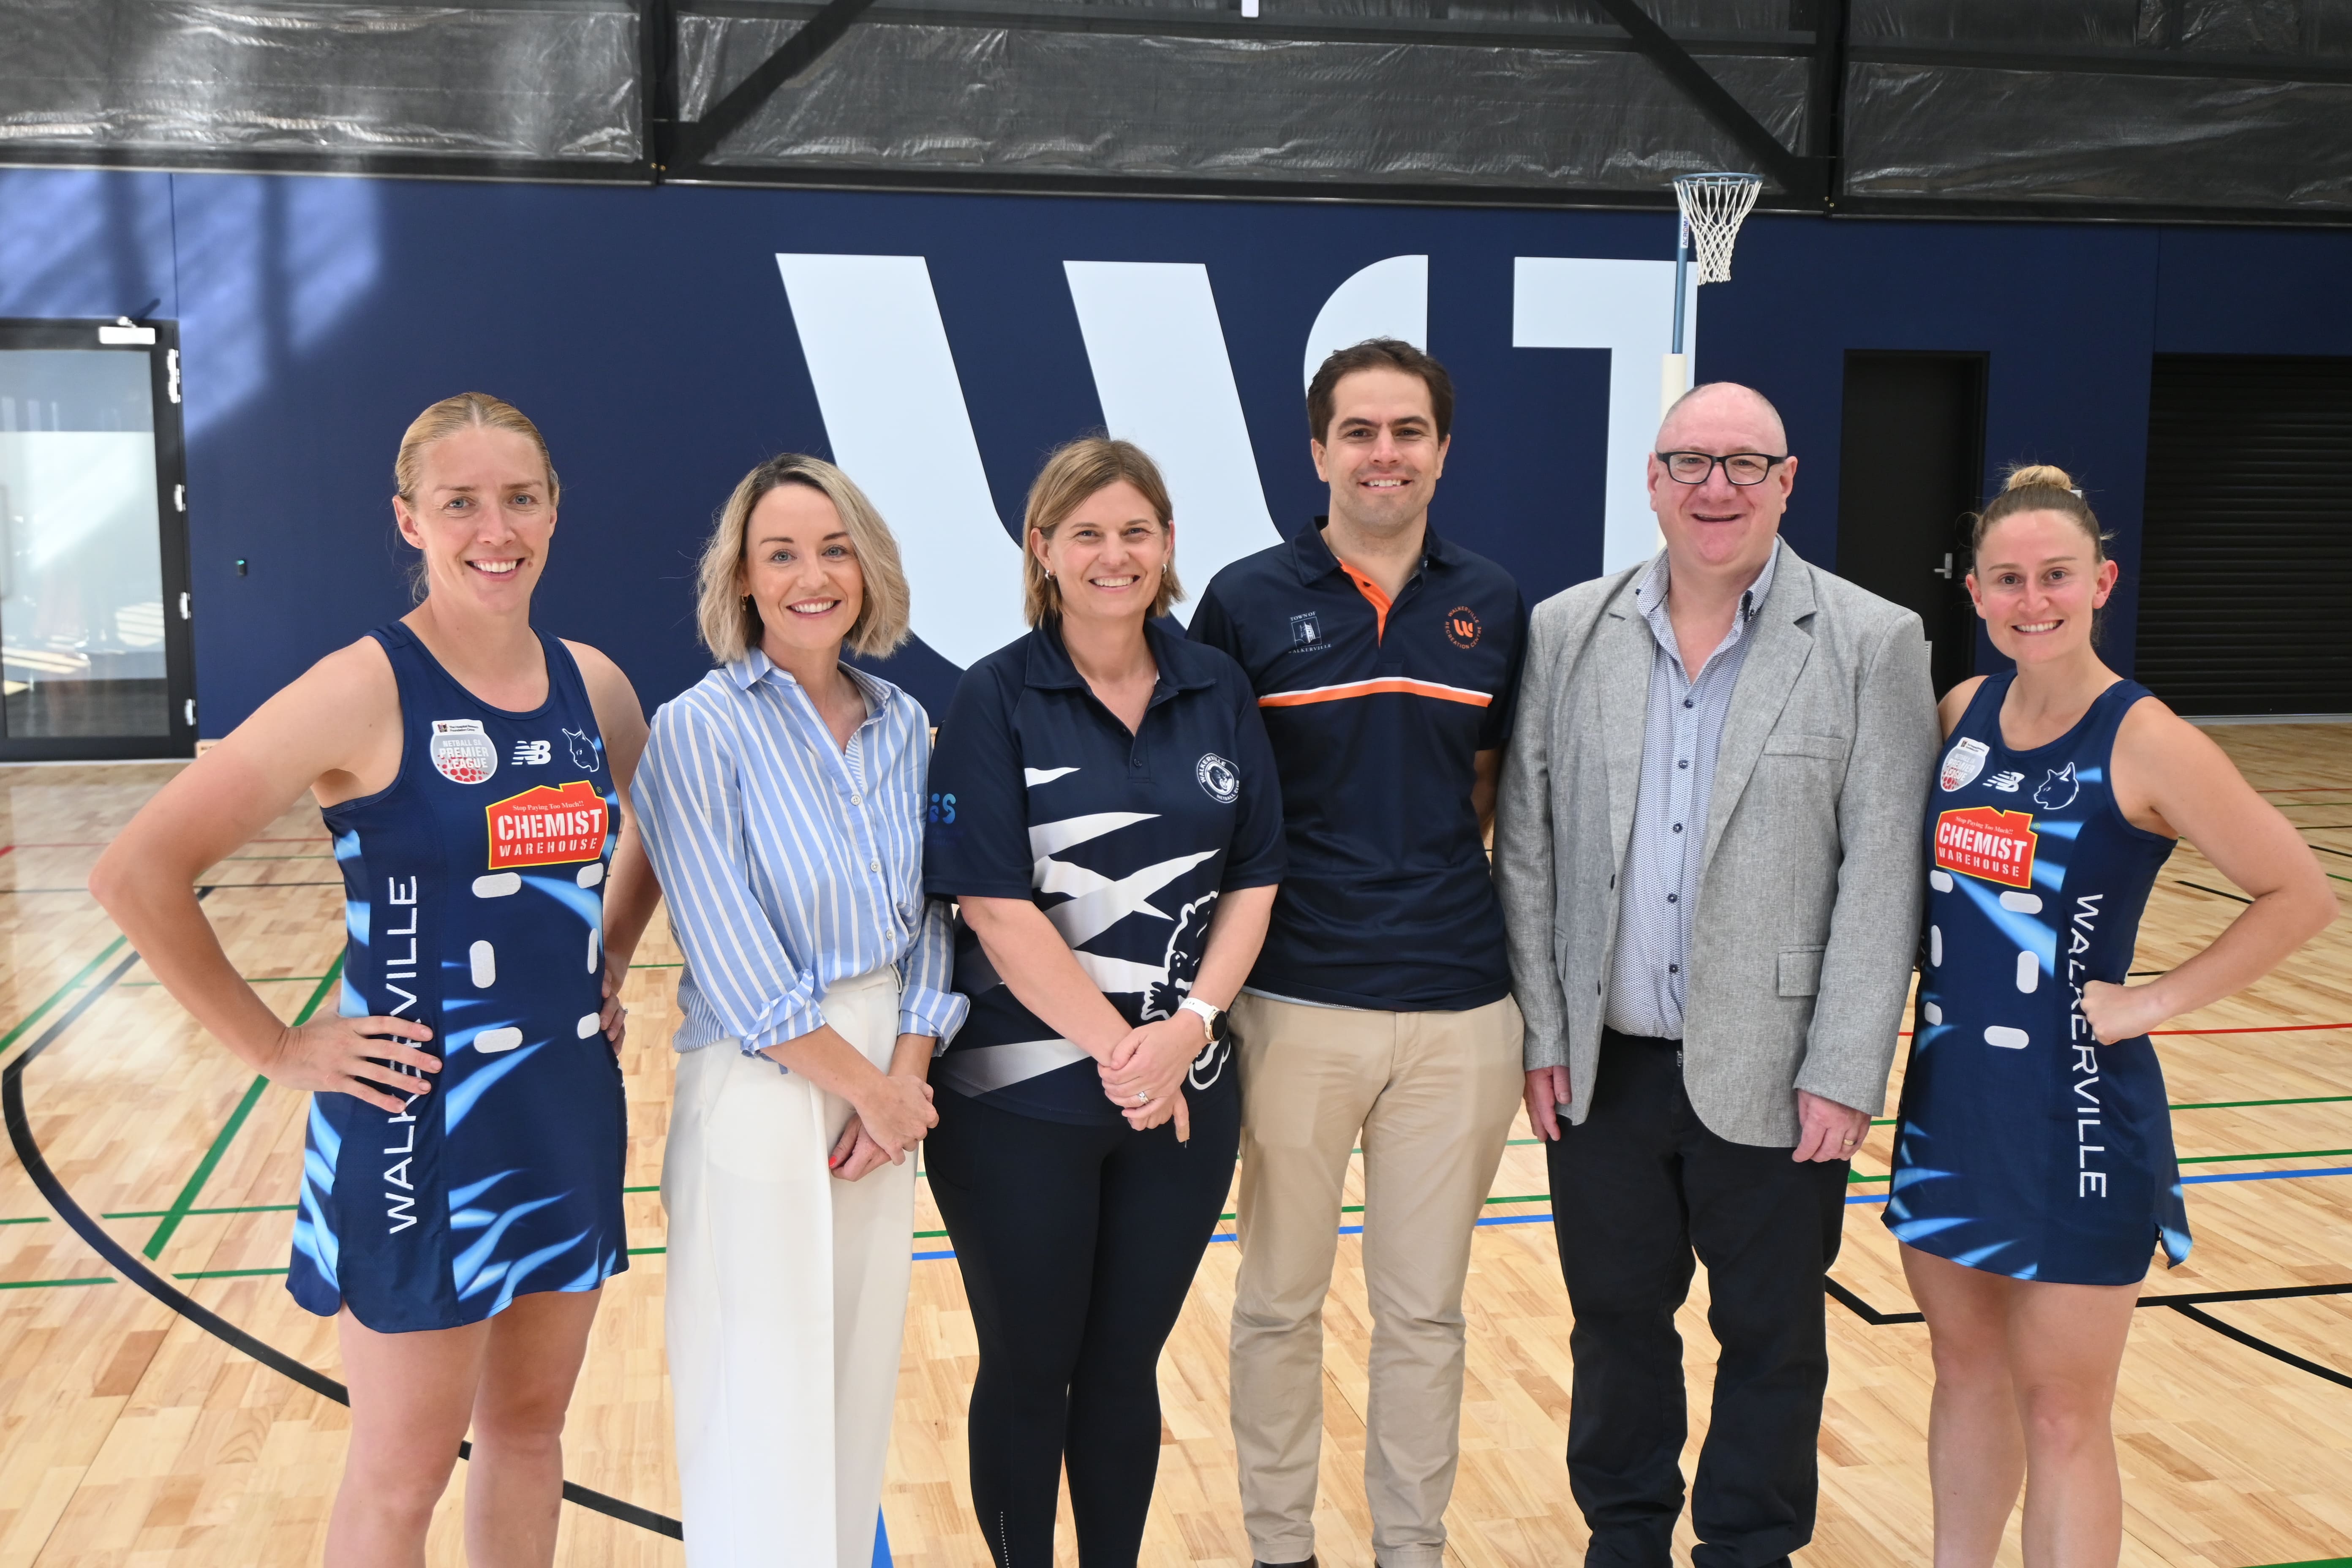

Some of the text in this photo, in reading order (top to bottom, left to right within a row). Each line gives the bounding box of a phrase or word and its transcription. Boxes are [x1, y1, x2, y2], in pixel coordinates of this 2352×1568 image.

[1290, 613, 1308, 621] TOWN
[1448, 606, 1479, 623] WALKERVILLE
[1446, 621, 1481, 649] RECREATION CENTRE
[439, 747, 489, 758] PREMIER
[446, 757, 488, 769] LEAGUE
[1199, 755, 1226, 783] WALKERVILLE
[528, 803, 549, 811] Paying
[561, 800, 584, 808] Much!!
[498, 808, 602, 841] CHEMIST
[1955, 816, 1966, 824] Stop
[1967, 819, 1984, 829] Paying
[499, 838, 598, 857] WAREHOUSE
[1939, 822, 2028, 862] CHEMIST
[1938, 847, 2020, 877] WAREHOUSE
[384, 876, 422, 1235] WALKVILLE
